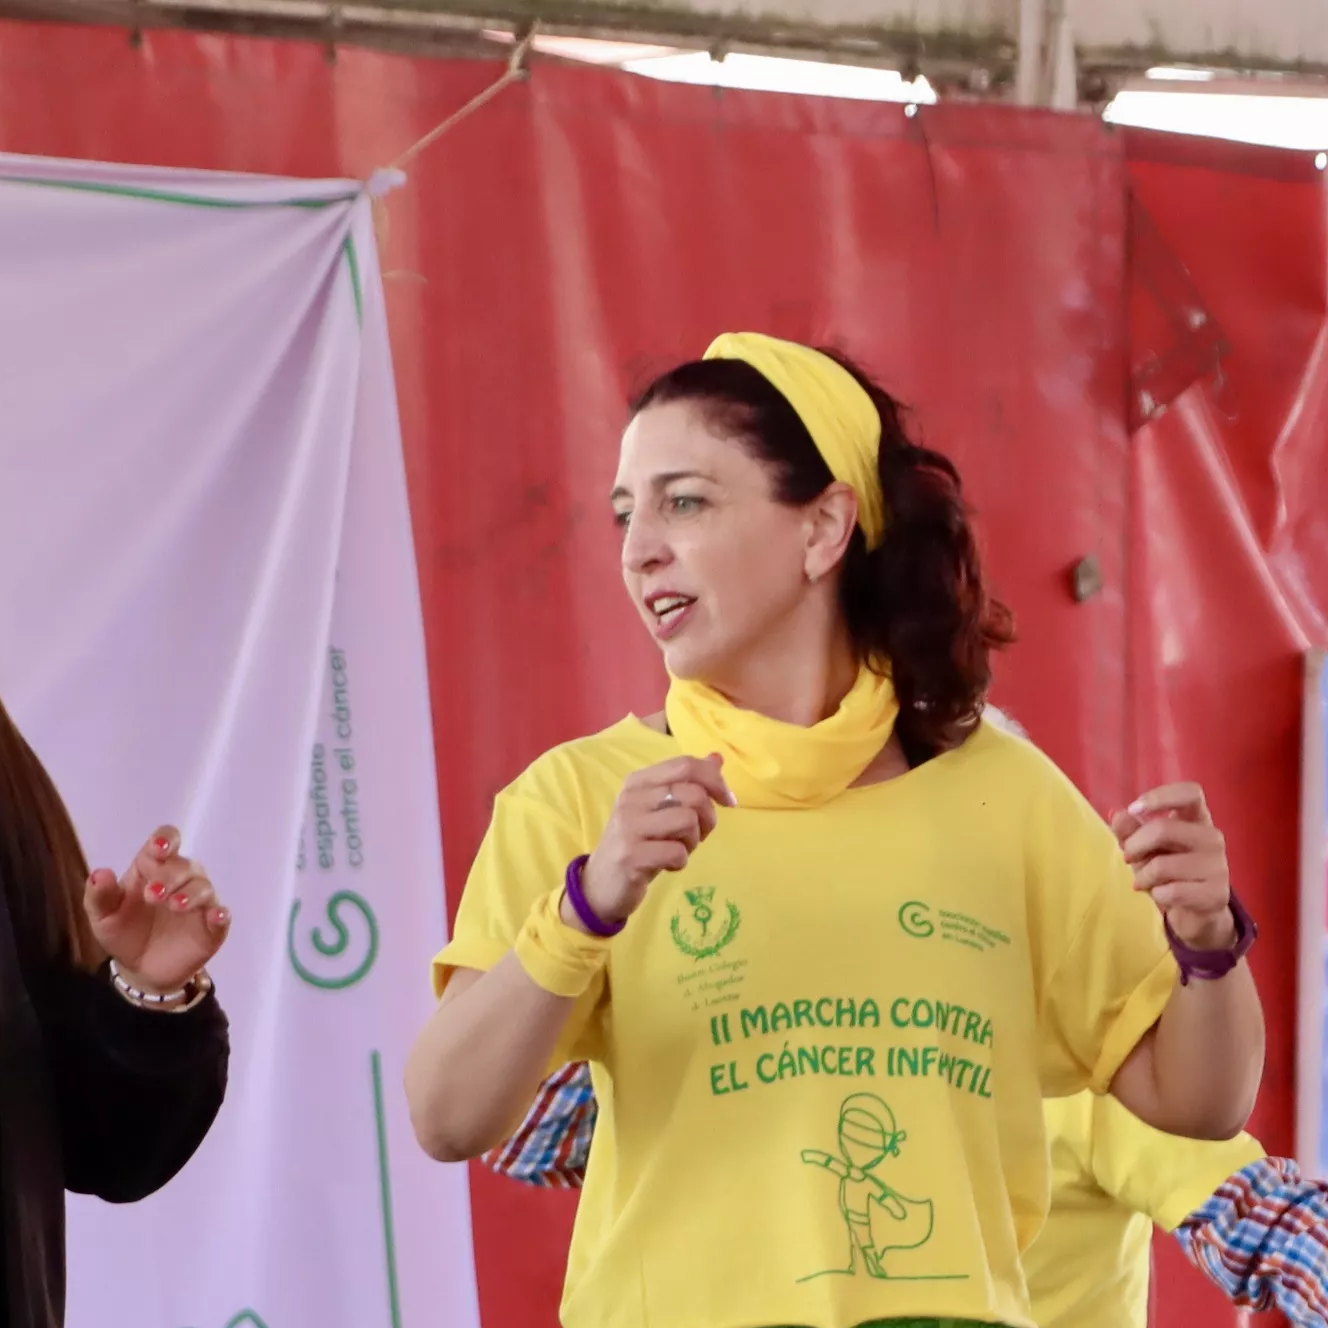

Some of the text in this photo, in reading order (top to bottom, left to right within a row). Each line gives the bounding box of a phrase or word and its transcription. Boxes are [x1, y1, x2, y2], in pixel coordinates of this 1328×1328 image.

[334, 748, 355, 771] el
[340, 779, 363, 867] contra
[710, 998, 993, 1049] II MARCHA CONTRA
[710, 1061, 748, 1096] EL
[756, 1040, 875, 1084] CÁNCER
